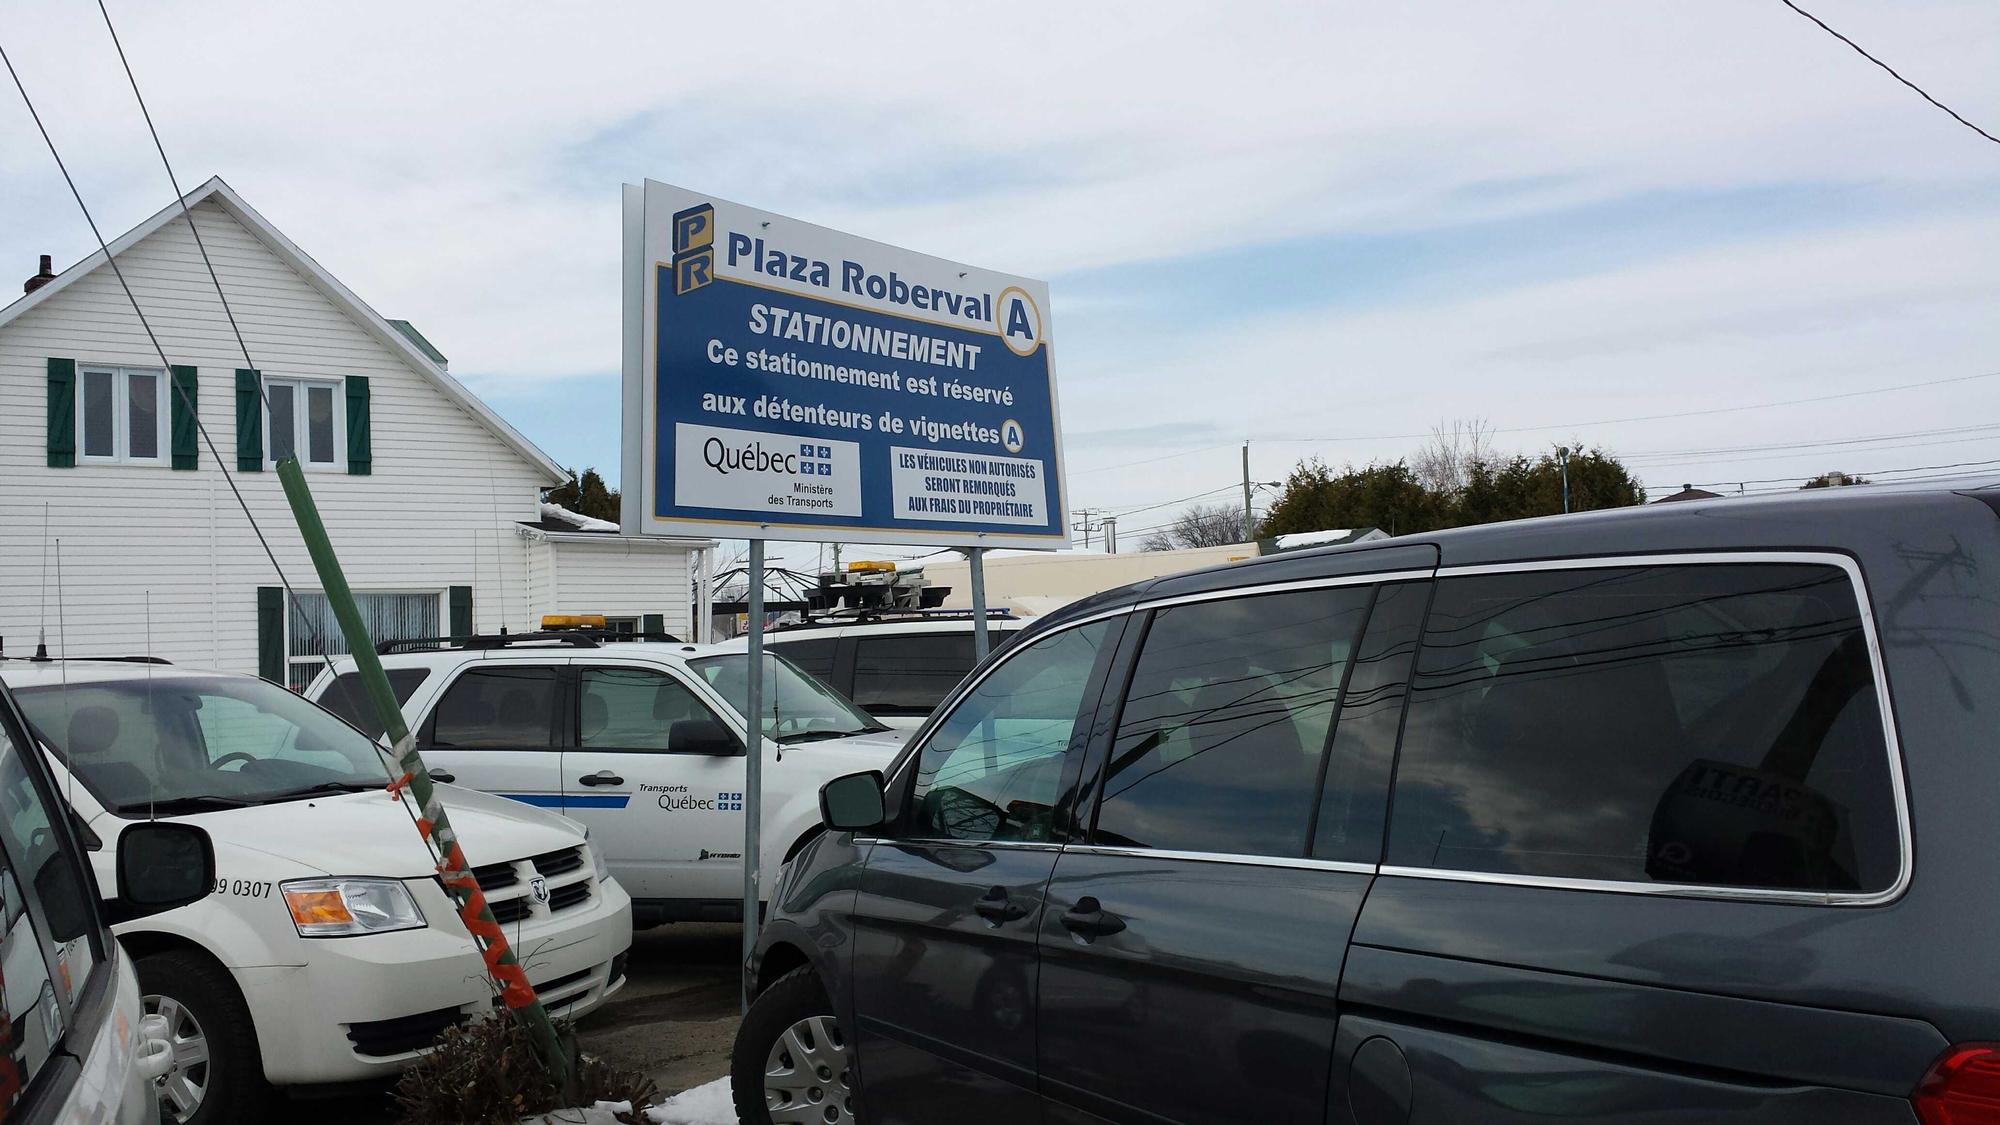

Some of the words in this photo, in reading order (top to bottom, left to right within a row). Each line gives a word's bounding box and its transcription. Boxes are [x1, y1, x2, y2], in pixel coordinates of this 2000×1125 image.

[679, 215, 706, 250] P
[681, 255, 710, 292] R
[728, 231, 830, 288] Plaza
[842, 259, 992, 323] Roberval
[1006, 297, 1034, 340] A
[749, 303, 982, 371] STATIONNEMENT
[707, 339, 739, 366] Ce
[745, 348, 901, 392] stationnement
[906, 375, 938, 397] est
[943, 378, 1014, 406] réservé
[702, 392, 746, 416] aux
[753, 394, 873, 432] détenteurs
[878, 411, 904, 434] de
[909, 415, 1000, 444] vignettes
[1007, 426, 1021, 447] A
[703, 436, 798, 475] Québec
[899, 453, 916, 470] LES
[917, 452, 968, 474] VÉHICULES
[968, 459, 988, 476] NON
[989, 462, 1036, 479] AUTORISÉS
[767, 494, 785, 506] des
[786, 495, 834, 510] Transports
[793, 482, 834, 496] Ministère
[925, 476, 962, 494] SERONT
[963, 479, 1016, 498] REMORQUÉS
[908, 496, 929, 513] AUX
[929, 498, 957, 515] FRAIS
[958, 499, 972, 515] DU
[973, 500, 1034, 518] PROPRIÉTAIRE
[639, 783, 688, 794] Transports
[658, 793, 715, 812] Québec
[232, 879, 272, 899] 0307
